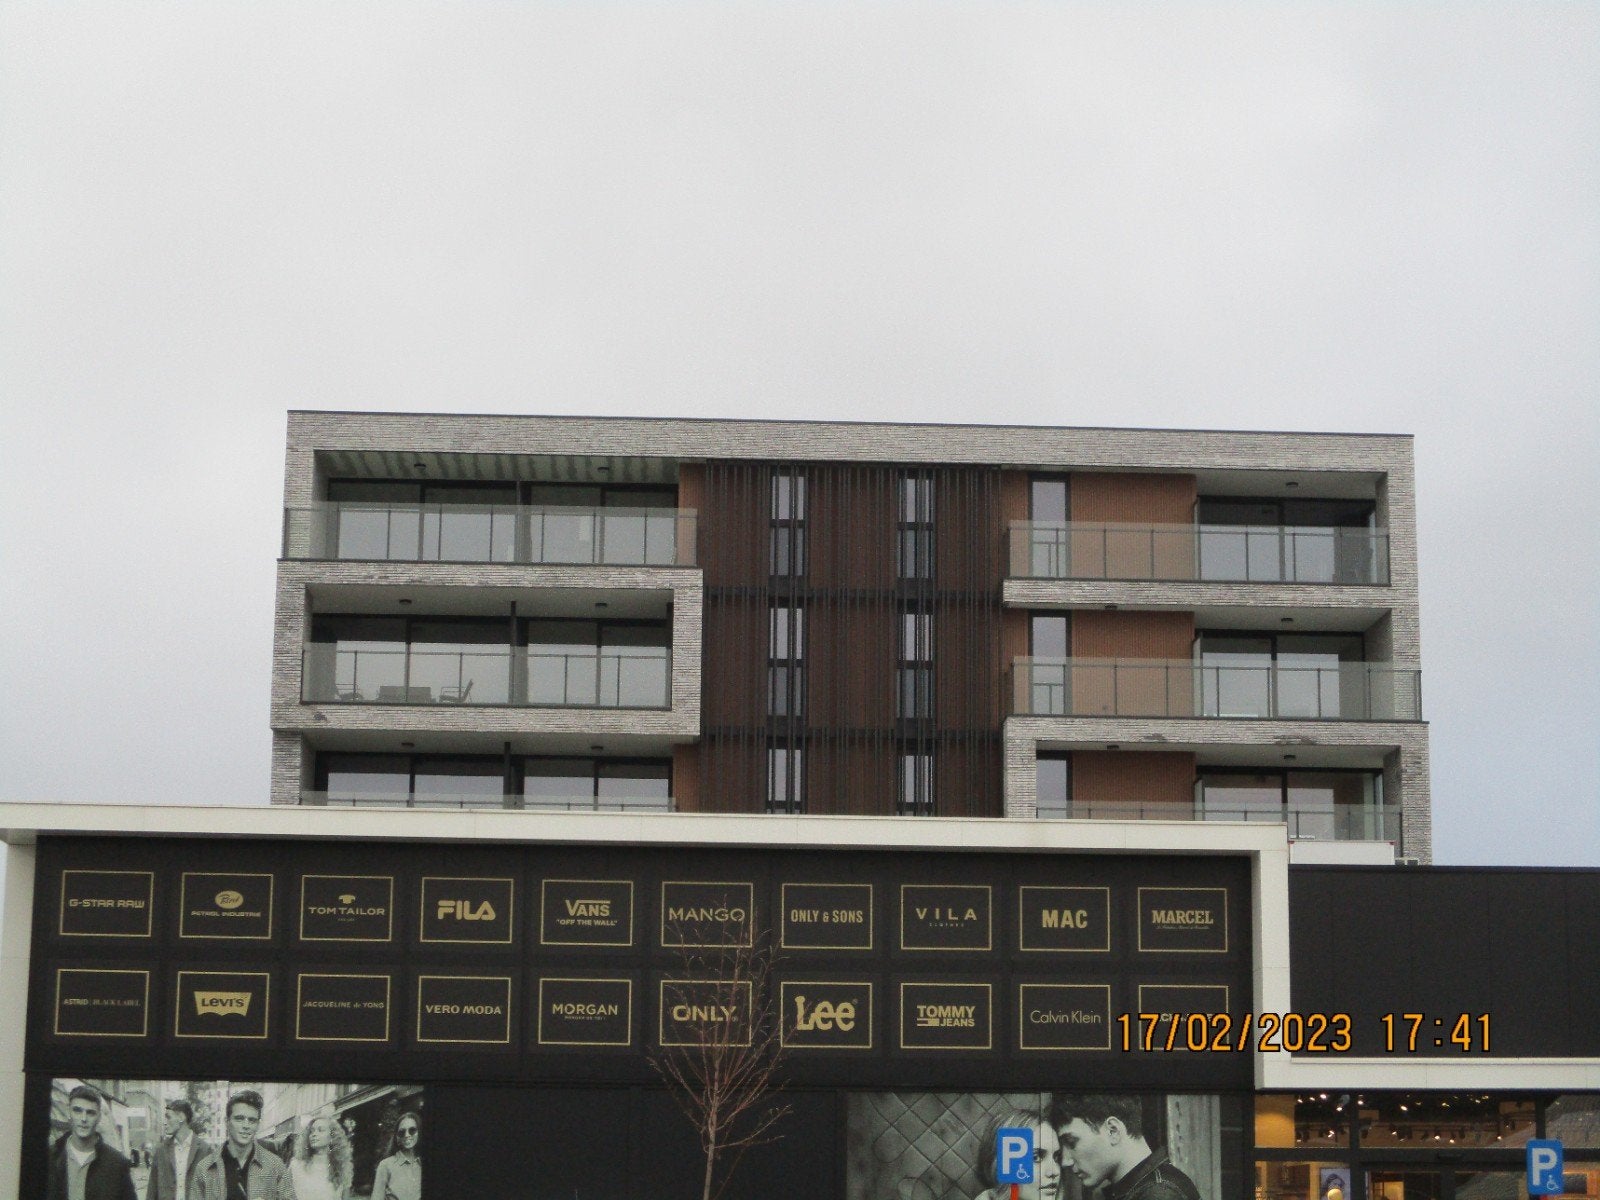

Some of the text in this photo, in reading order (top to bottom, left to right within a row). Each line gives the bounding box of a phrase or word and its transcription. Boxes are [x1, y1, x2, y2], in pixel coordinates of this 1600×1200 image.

[69, 899, 145, 909] G-STAR RAW
[308, 906, 385, 916] TOM TAILOR
[437, 900, 496, 921] FILA
[565, 899, 611, 917] VANS
[668, 907, 745, 922] MANGO
[790, 909, 864, 924] ONLY & SONS
[916, 907, 978, 921] VILA
[1042, 909, 1088, 929] MAC
[1152, 910, 1214, 924] MARCEL
[425, 1004, 502, 1015] VERO MODA
[552, 1003, 618, 1015] MORGAN
[672, 1005, 737, 1022] ONLY
[795, 995, 856, 1032] Lee
[917, 1005, 976, 1018] TOMMY
[1030, 1009, 1101, 1024] Calvin Klein
[940, 1018, 975, 1027] JEANS
[1002, 1136, 1028, 1175] P
[1532, 1147, 1557, 1186] P
